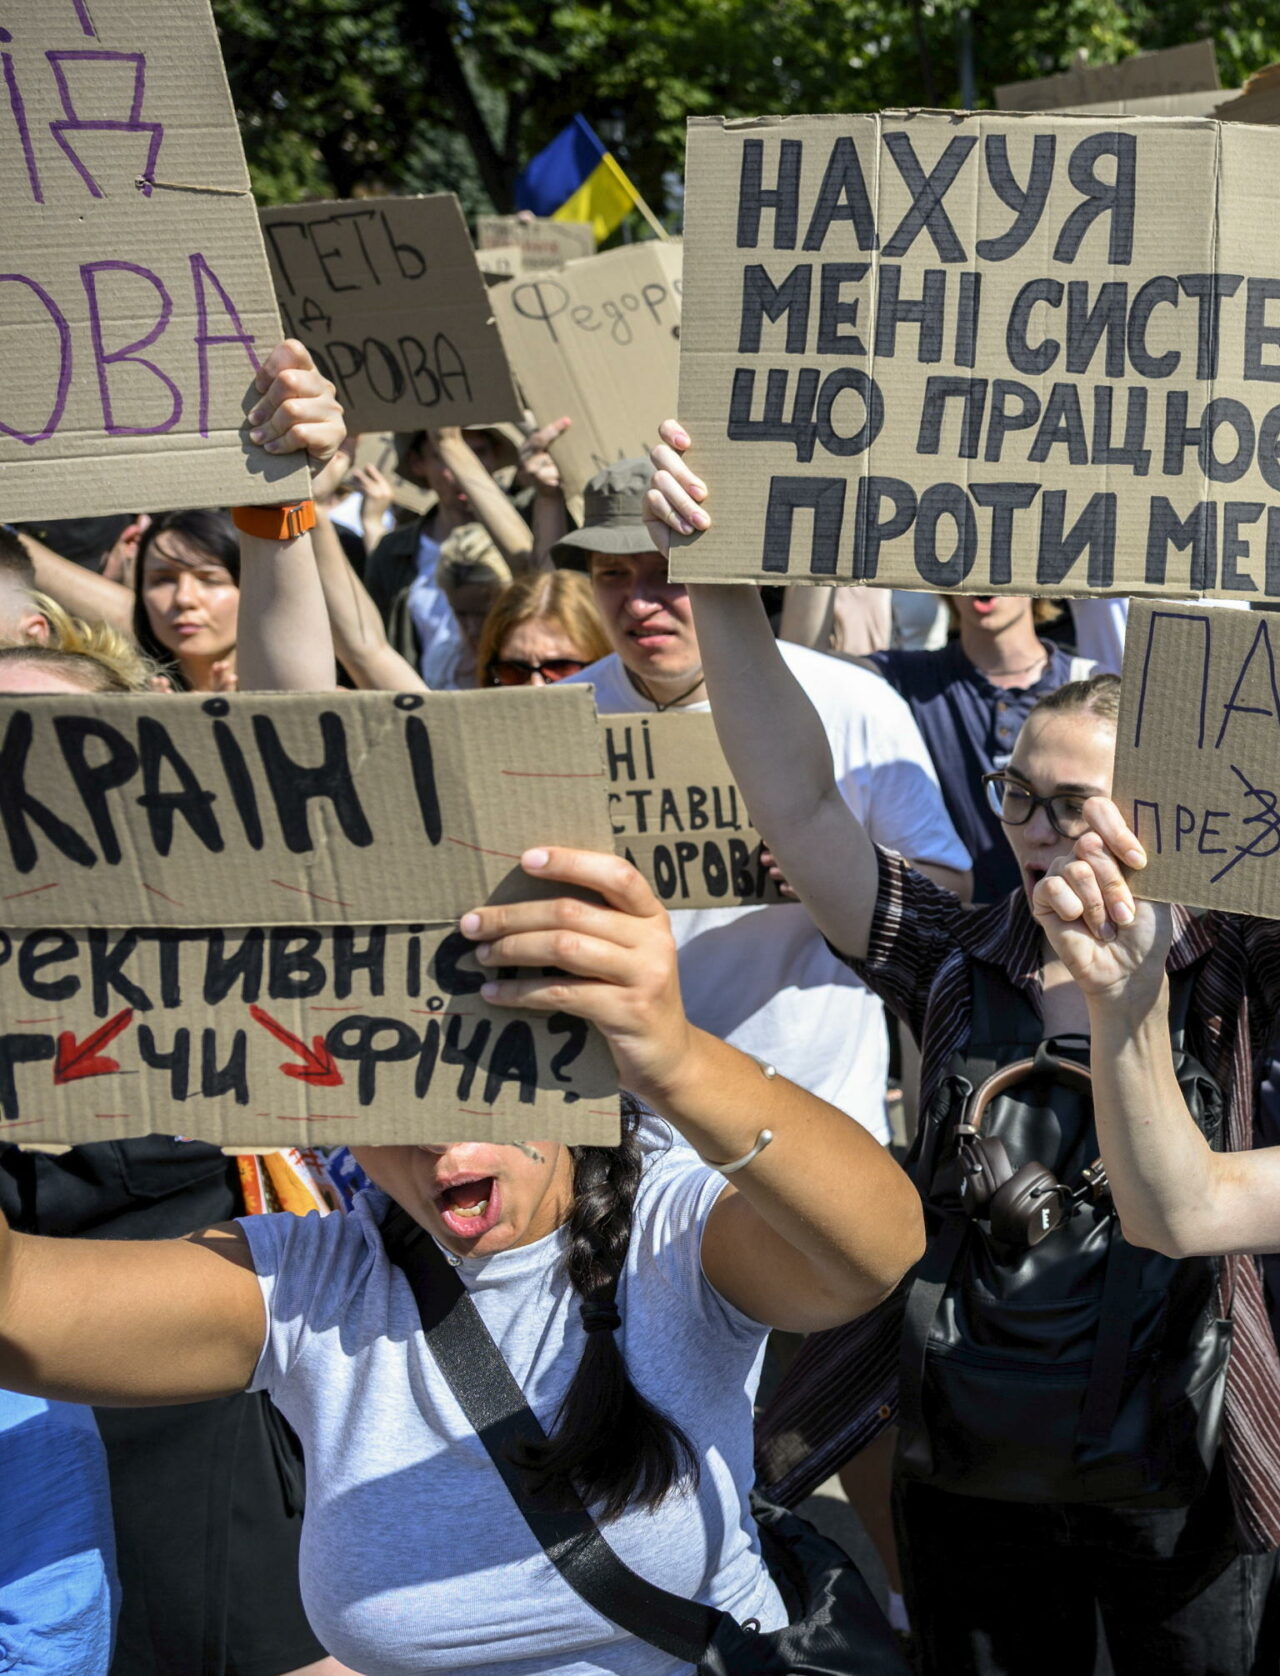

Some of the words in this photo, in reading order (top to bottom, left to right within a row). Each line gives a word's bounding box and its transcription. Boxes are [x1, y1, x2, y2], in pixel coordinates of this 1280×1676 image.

[736, 131, 1137, 265] НАХУЯ
[265, 208, 427, 297] ГЕТЬ
[737, 262, 981, 368] МЕНІ
[726, 367, 886, 462] ЩО
[761, 475, 1118, 588] ПРОТИ
[608, 785, 754, 835] СТАВЦ
[624, 838, 788, 899] ОРОВА
[137, 1023, 250, 1106] ЧИ
[325, 995, 589, 1107] ФІЧА?
